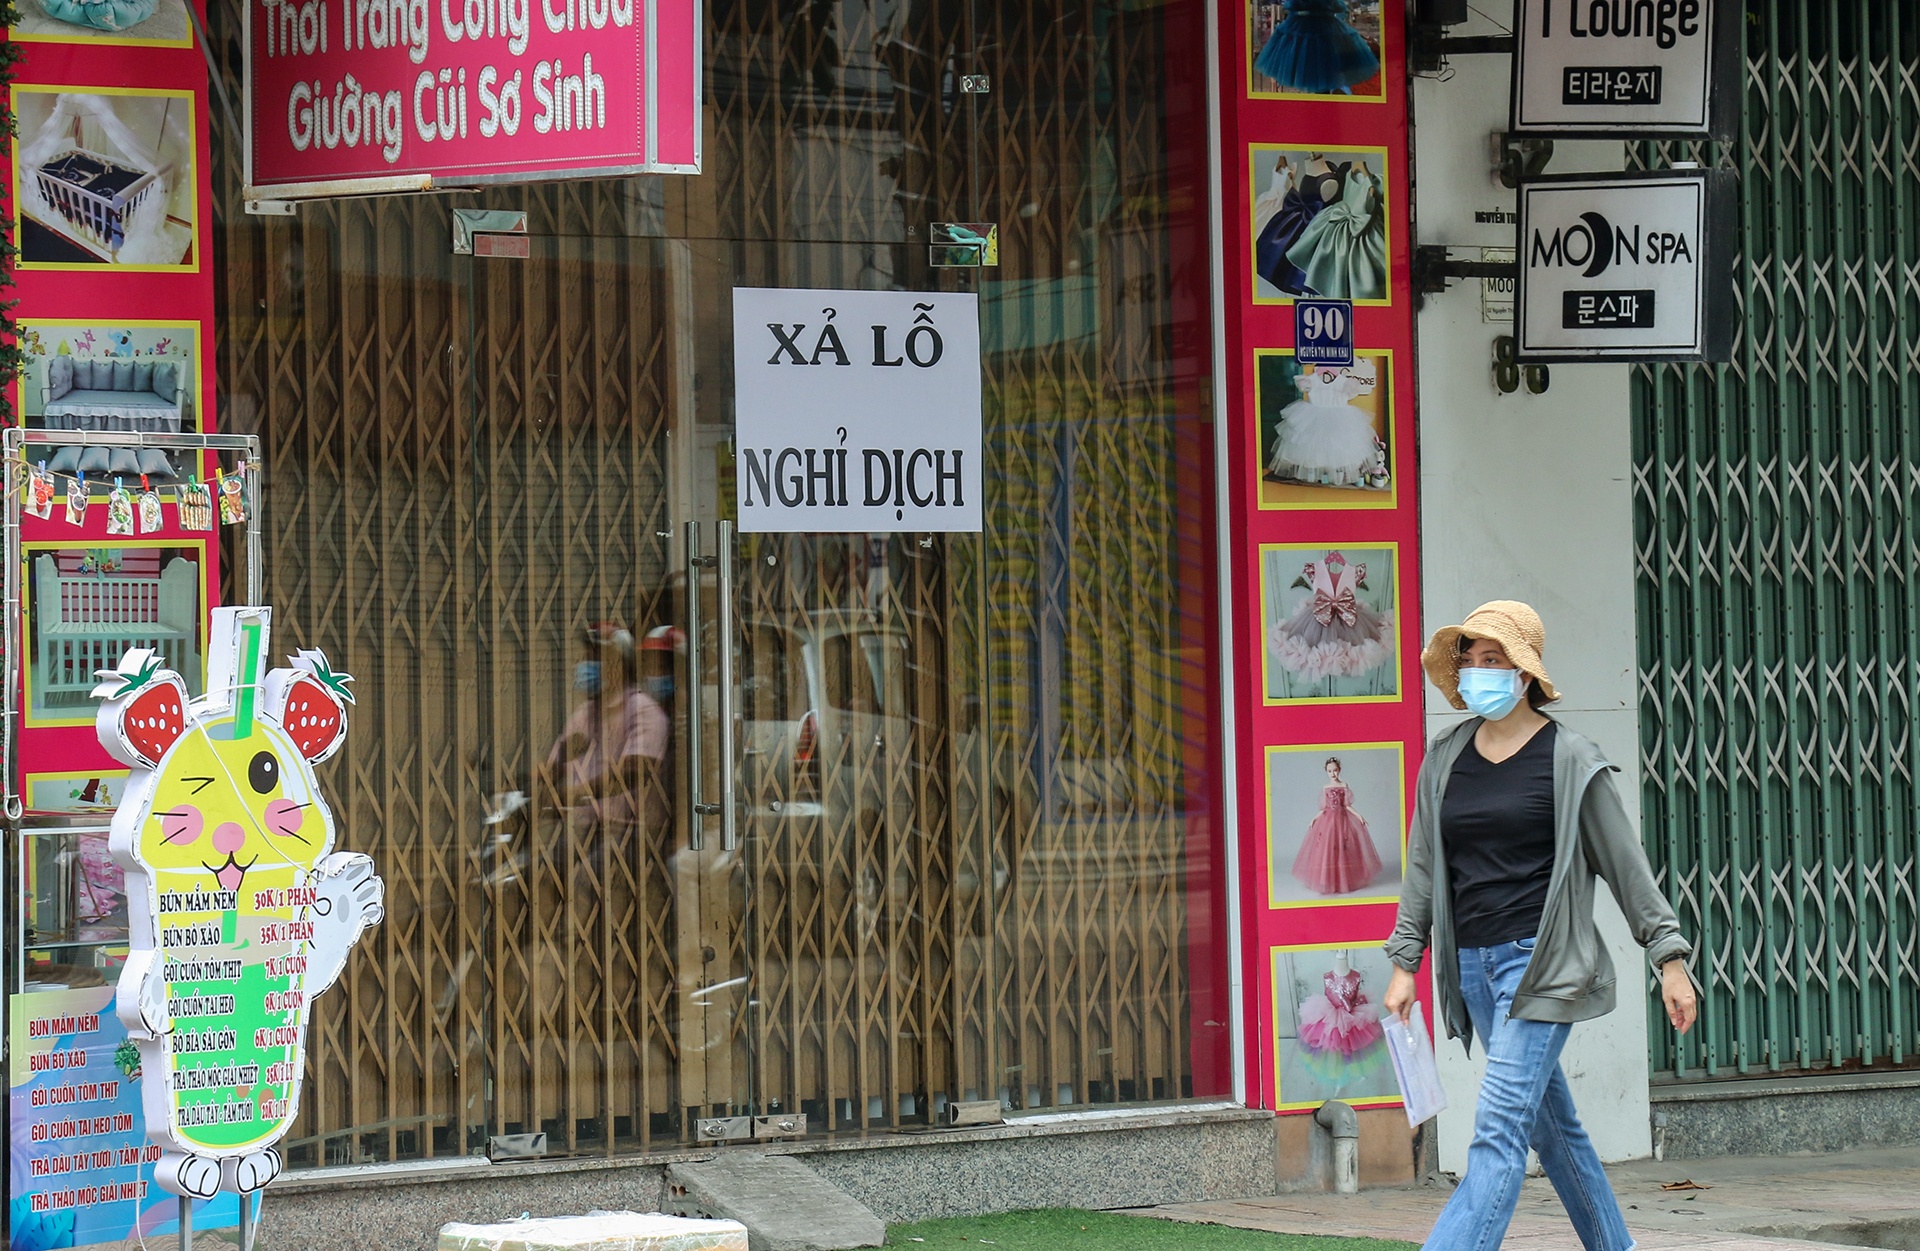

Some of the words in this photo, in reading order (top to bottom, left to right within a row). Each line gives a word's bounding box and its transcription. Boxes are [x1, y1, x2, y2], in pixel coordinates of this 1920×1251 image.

[1570, 0, 1700, 49] Lounge
[1568, 71, 1656, 101] 티라운지
[287, 72, 403, 163] Giường
[413, 66, 468, 142] Cũi
[478, 65, 522, 138] Sơ
[533, 52, 606, 134] Sinh
[1531, 211, 1640, 278] MOON
[1646, 231, 1692, 264] SPA
[1303, 306, 1345, 341] 90
[1577, 295, 1640, 325] 문스파
[767, 308, 851, 366] XẢ
[871, 302, 944, 368] LỖ
[743, 426, 849, 508] NGHỈ
[862, 448, 965, 522] DỊCH
[160, 889, 183, 913] BÚN
[185, 883, 210, 912] MẮM
[213, 886, 236, 910] NÊM
[255, 889, 284, 911] 30K/1
[287, 878, 317, 906] PHẦN
[163, 924, 183, 948] BÚN
[185, 923, 198, 946] BÒ
[200, 922, 220, 945] XÀO
[260, 923, 285, 945] 35K/1
[289, 913, 314, 940] PHẦN
[163, 956, 178, 982] GỎI
[180, 954, 203, 981] CUỐN
[204, 957, 221, 979] TÔM
[223, 960, 242, 983] THỊT
[285, 948, 307, 974] CUỐN
[168, 991, 181, 1017] GỎI
[183, 988, 203, 1015] CUỐN
[205, 997, 218, 1015] TAI
[219, 995, 234, 1013] HEO
[283, 982, 303, 1010] CUỐN
[30, 1016, 49, 1036] BÚN
[51, 1011, 75, 1034] MẮM
[78, 1012, 99, 1032] NÊM
[172, 1029, 184, 1053] BÒ
[185, 1028, 200, 1052] BÍA
[202, 1027, 216, 1051] SÀI
[218, 1026, 236, 1050] GÒN
[275, 1018, 298, 1045] CUỐN
[30, 1051, 50, 1071] BÚN
[52, 1048, 64, 1069] BÒ
[67, 1047, 86, 1068] XÀO
[173, 1065, 186, 1090] TRÀ
[285, 1063, 294, 1080] LY
[31, 1084, 47, 1106] GỎI
[50, 1081, 75, 1104] CUỐN
[78, 1081, 97, 1101] TÔM
[99, 1081, 118, 1101] THỊT
[31, 1119, 47, 1141] GỎI
[51, 1115, 76, 1139] CUỐN
[78, 1119, 91, 1136] TAI
[93, 1117, 111, 1134] HEO
[113, 1112, 132, 1132] TÔM
[178, 1101, 190, 1126] TRÀ
[279, 1099, 288, 1117] LY
[30, 1155, 50, 1176] TRÀ
[52, 1153, 71, 1173] DÂU
[73, 1151, 89, 1171] TÂY
[30, 1190, 50, 1211] TRÀ
[52, 1185, 75, 1209] THẢO
[77, 1184, 97, 1208] MỘC
[100, 1180, 118, 1202] GIẢI
